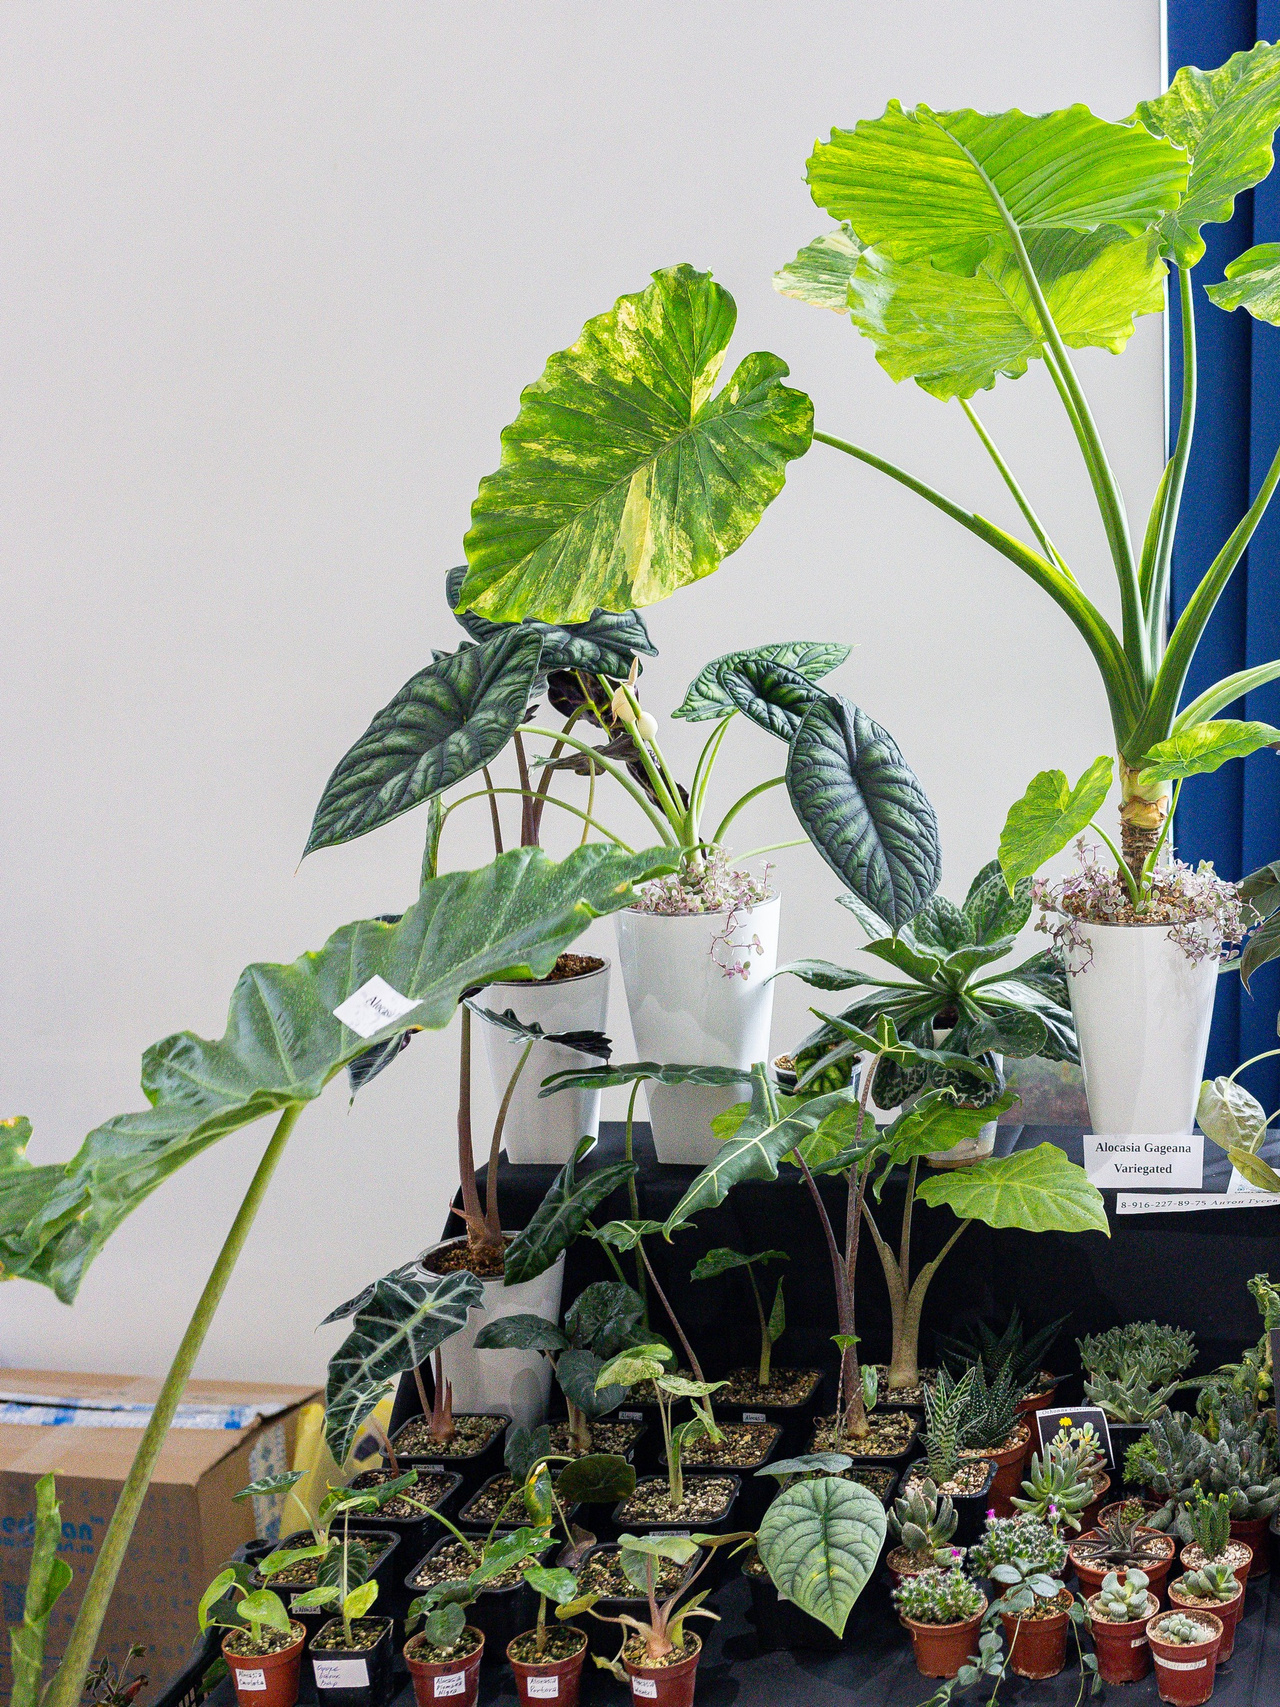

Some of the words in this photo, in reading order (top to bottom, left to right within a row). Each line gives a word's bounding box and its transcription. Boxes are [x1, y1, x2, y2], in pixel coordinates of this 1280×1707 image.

[1095, 1142, 1141, 1153] Alocasia
[1144, 1142, 1192, 1156] Gageana
[1113, 1163, 1173, 1176] Variegated
[1120, 1200, 1207, 1209] 8-916-227-89-75
